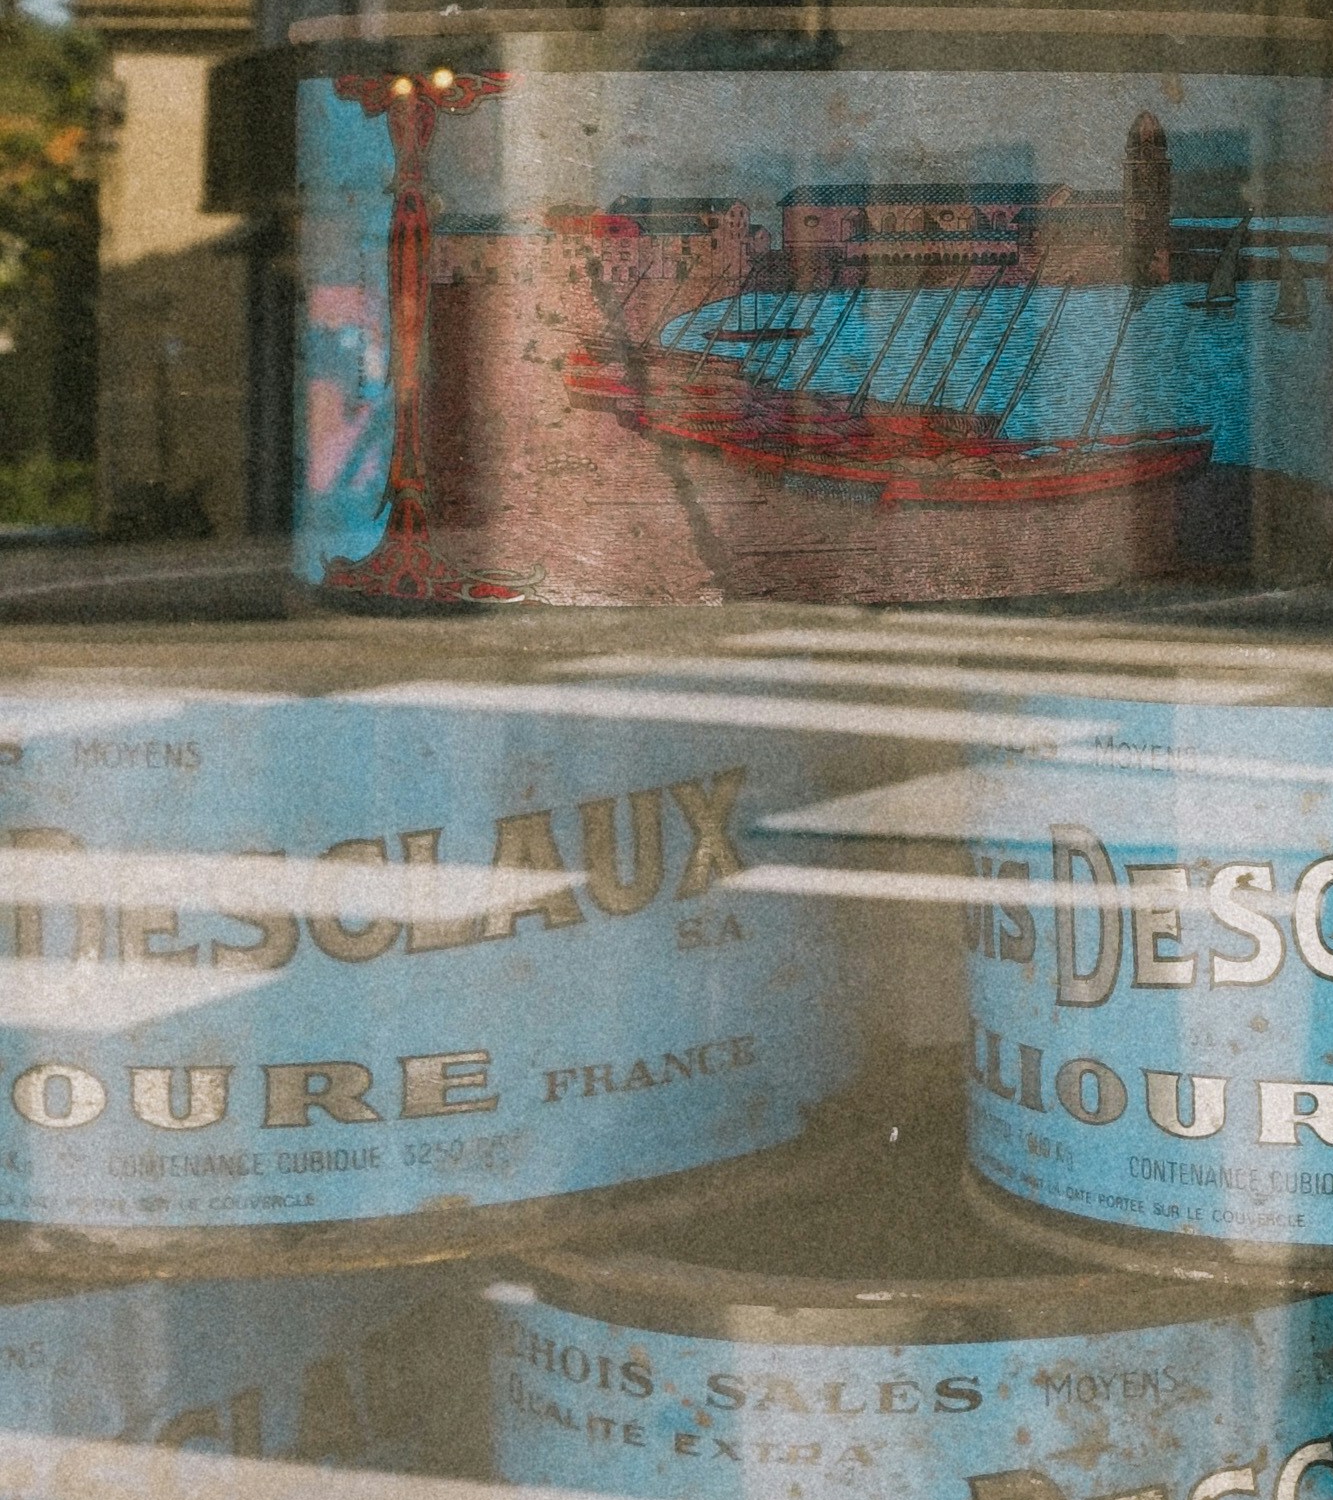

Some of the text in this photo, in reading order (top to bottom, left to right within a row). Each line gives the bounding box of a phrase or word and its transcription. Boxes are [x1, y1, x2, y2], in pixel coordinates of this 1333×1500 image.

[72, 737, 202, 772] MOYENS
[541, 1033, 762, 1105] FRANCE
[1128, 1155, 1260, 1194] CONTENANCE
[1154, 1203, 1180, 1218] SUR
[1186, 1205, 1203, 1221] LE
[1042, 1364, 1180, 1408] MOYENS
